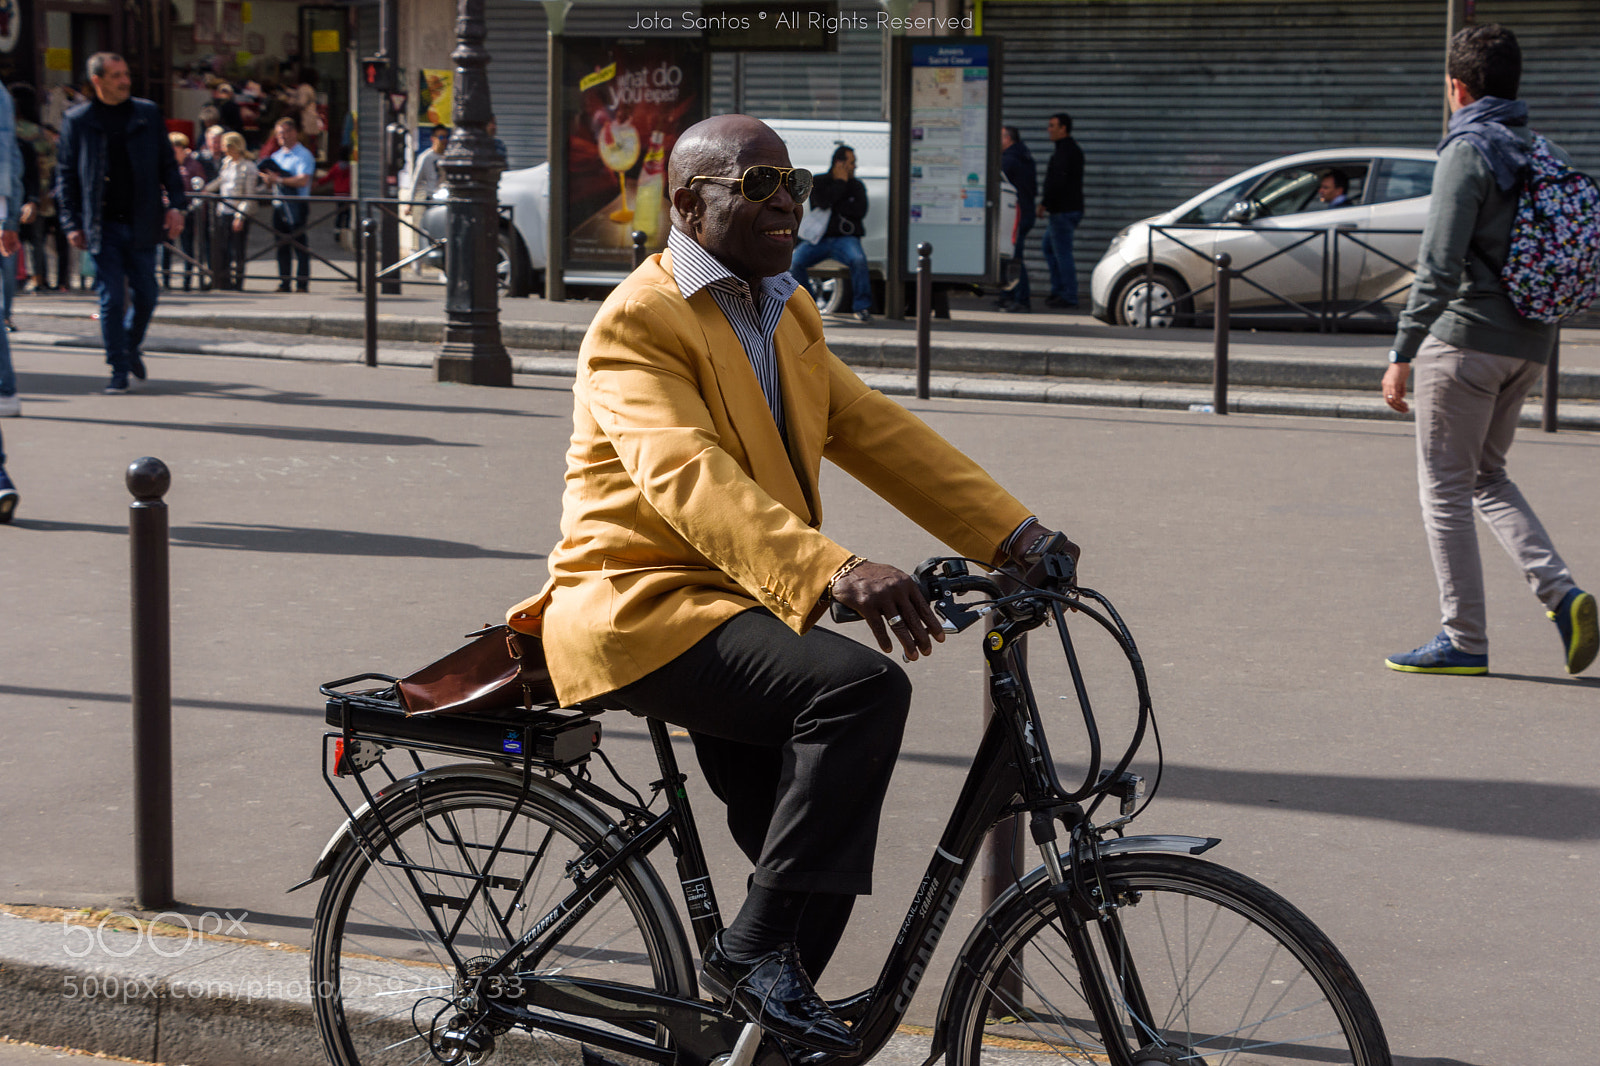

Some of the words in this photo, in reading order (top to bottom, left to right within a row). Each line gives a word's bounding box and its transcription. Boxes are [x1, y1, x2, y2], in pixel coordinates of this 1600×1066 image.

[652, 61, 682, 88] do
[608, 85, 642, 111] you
[897, 871, 931, 945] E-RAILWAY
[919, 877, 940, 919] SCRAPPER
[523, 908, 560, 946] SCRAPPER
